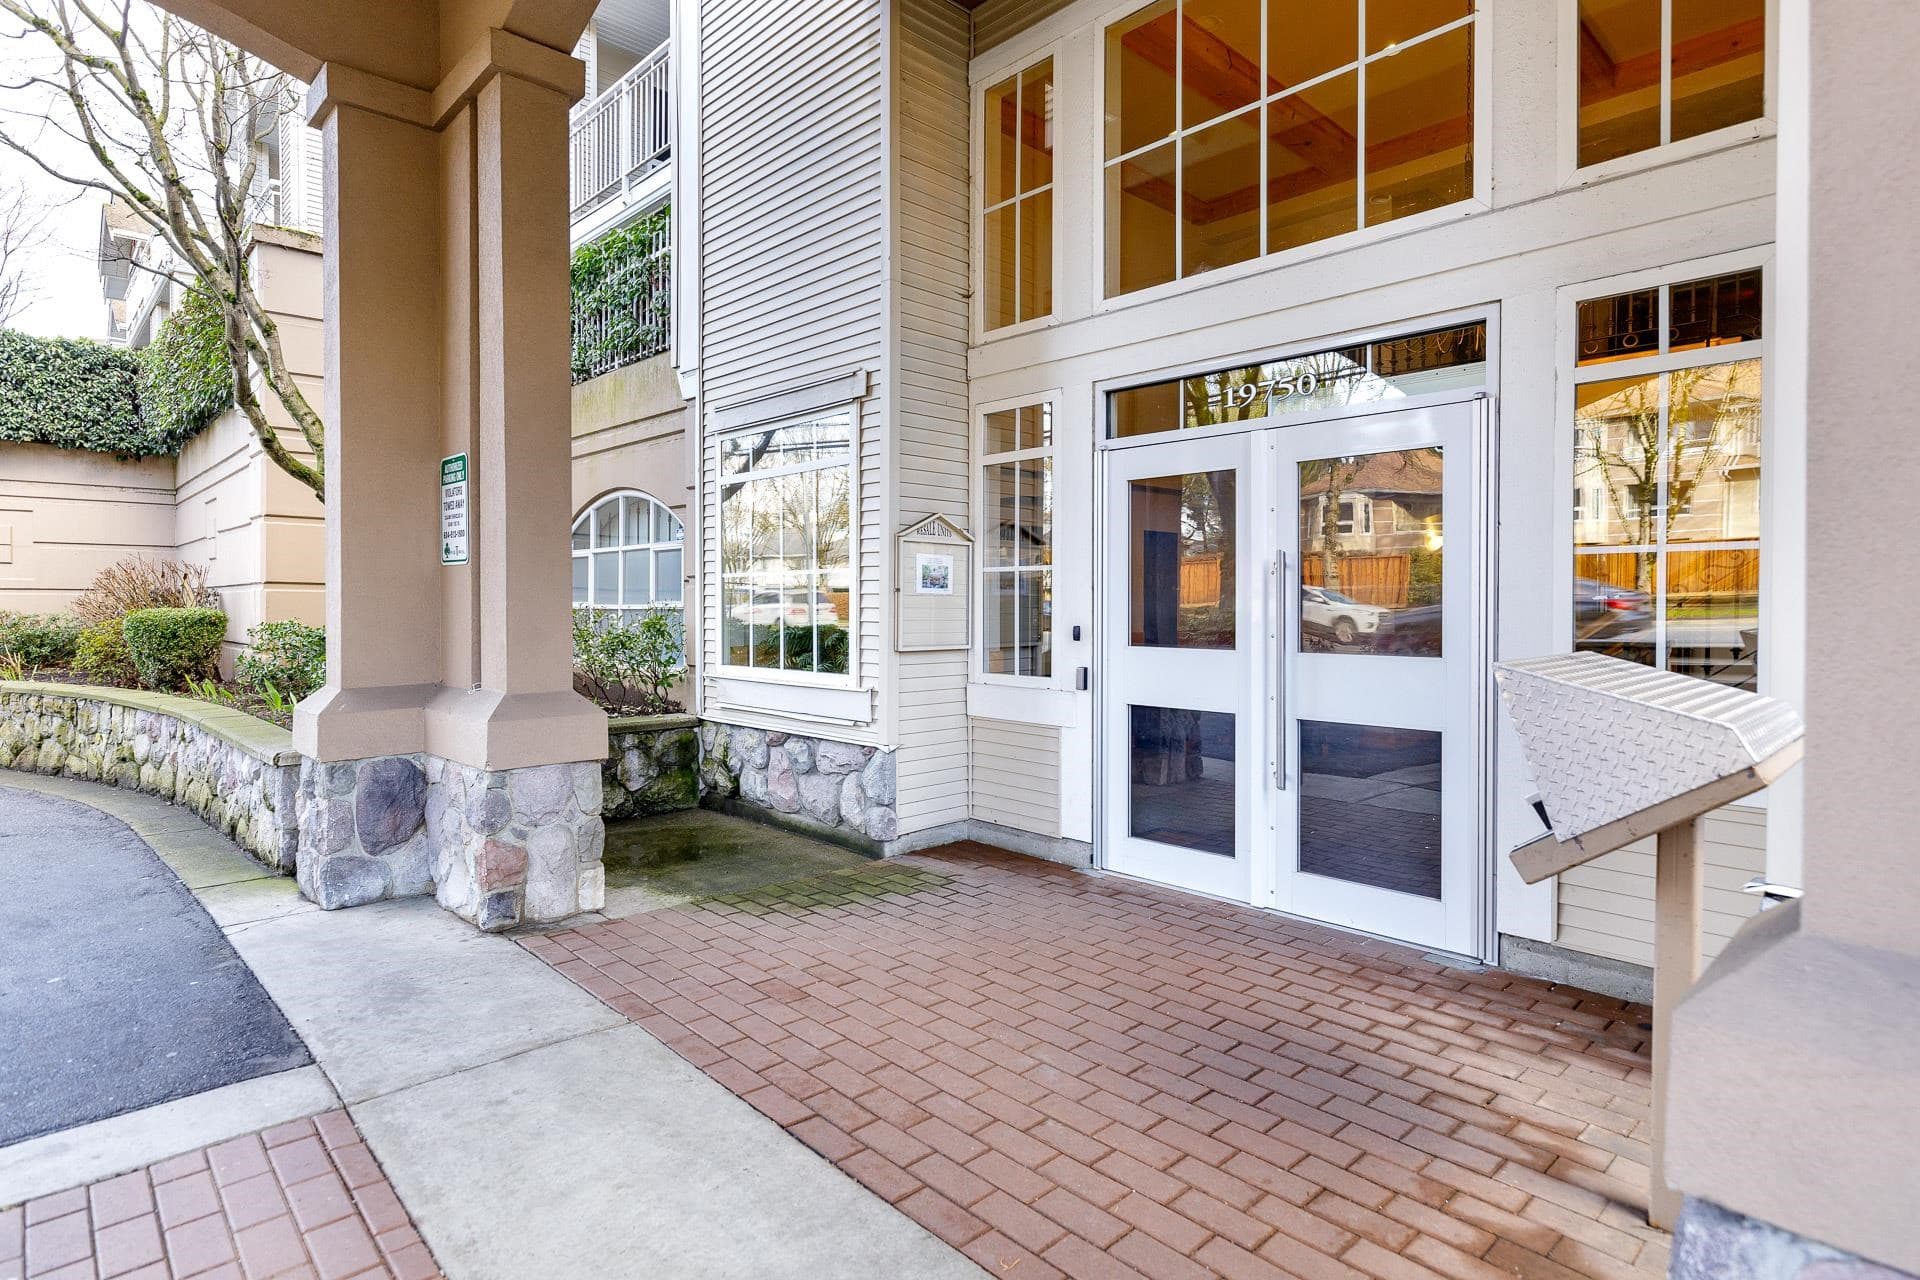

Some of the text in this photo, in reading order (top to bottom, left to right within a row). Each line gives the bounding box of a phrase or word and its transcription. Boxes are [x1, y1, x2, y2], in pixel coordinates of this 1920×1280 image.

[1222, 373, 1316, 408] 19750
[445, 486, 463, 498] VIOLATORS
[443, 499, 465, 511] TOWED AWAY
[916, 520, 936, 536] RESALE
